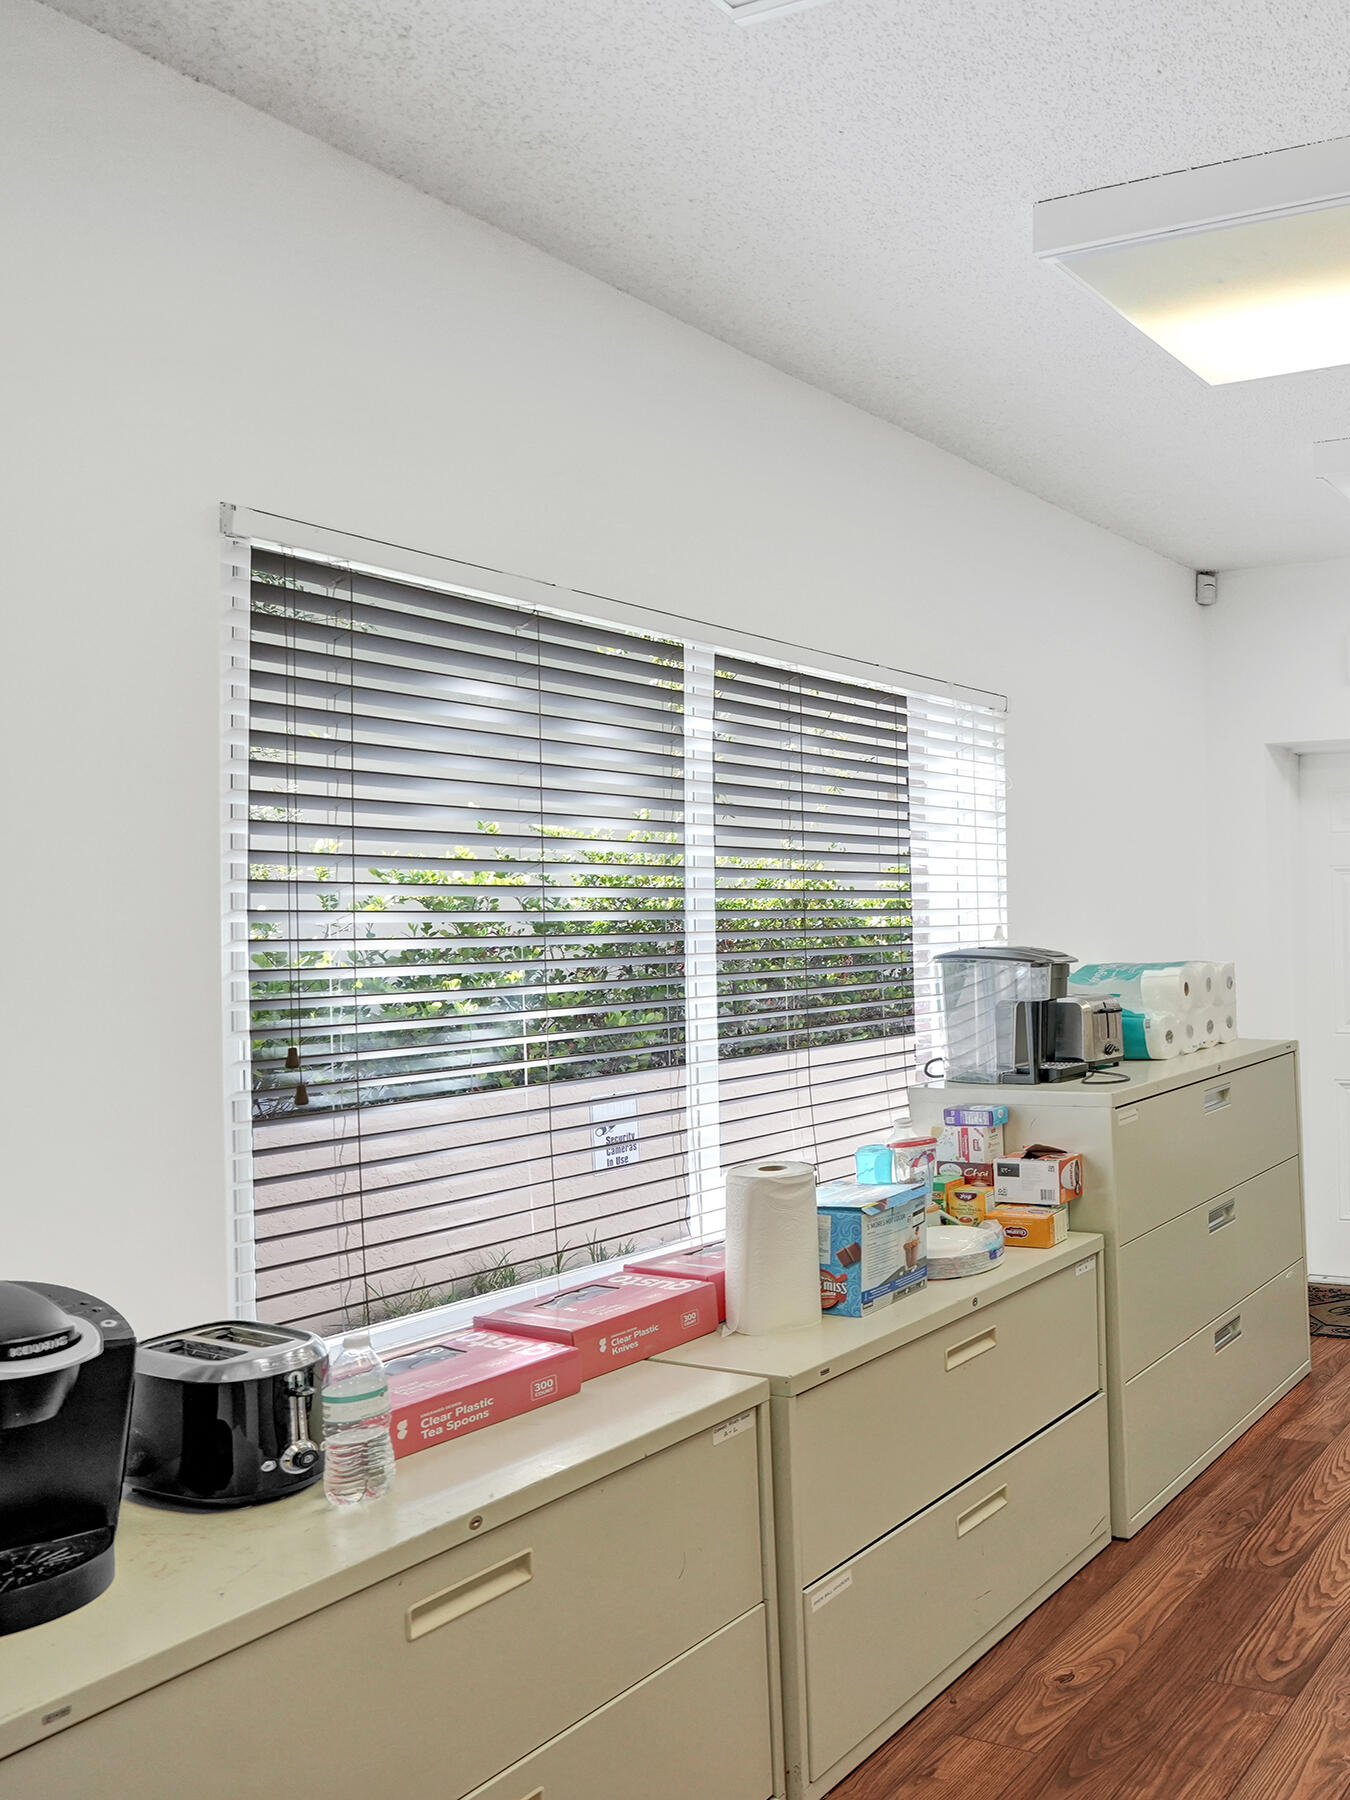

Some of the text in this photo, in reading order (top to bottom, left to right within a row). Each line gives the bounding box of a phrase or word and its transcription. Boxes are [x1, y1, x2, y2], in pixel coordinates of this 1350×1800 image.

[606, 1132, 636, 1145] Security
[616, 1156, 629, 1166] Use
[963, 1166, 989, 1178] Chai
[683, 1311, 698, 1322] 300
[611, 1333, 632, 1347] Clear
[634, 1323, 660, 1342] Plastic
[611, 1340, 640, 1356] Knives
[534, 1379, 553, 1393] 300
[420, 1410, 453, 1429] Clear
[455, 1397, 495, 1418] Plastic
[420, 1426, 444, 1440] Tea
[446, 1409, 490, 1432] Spoons
